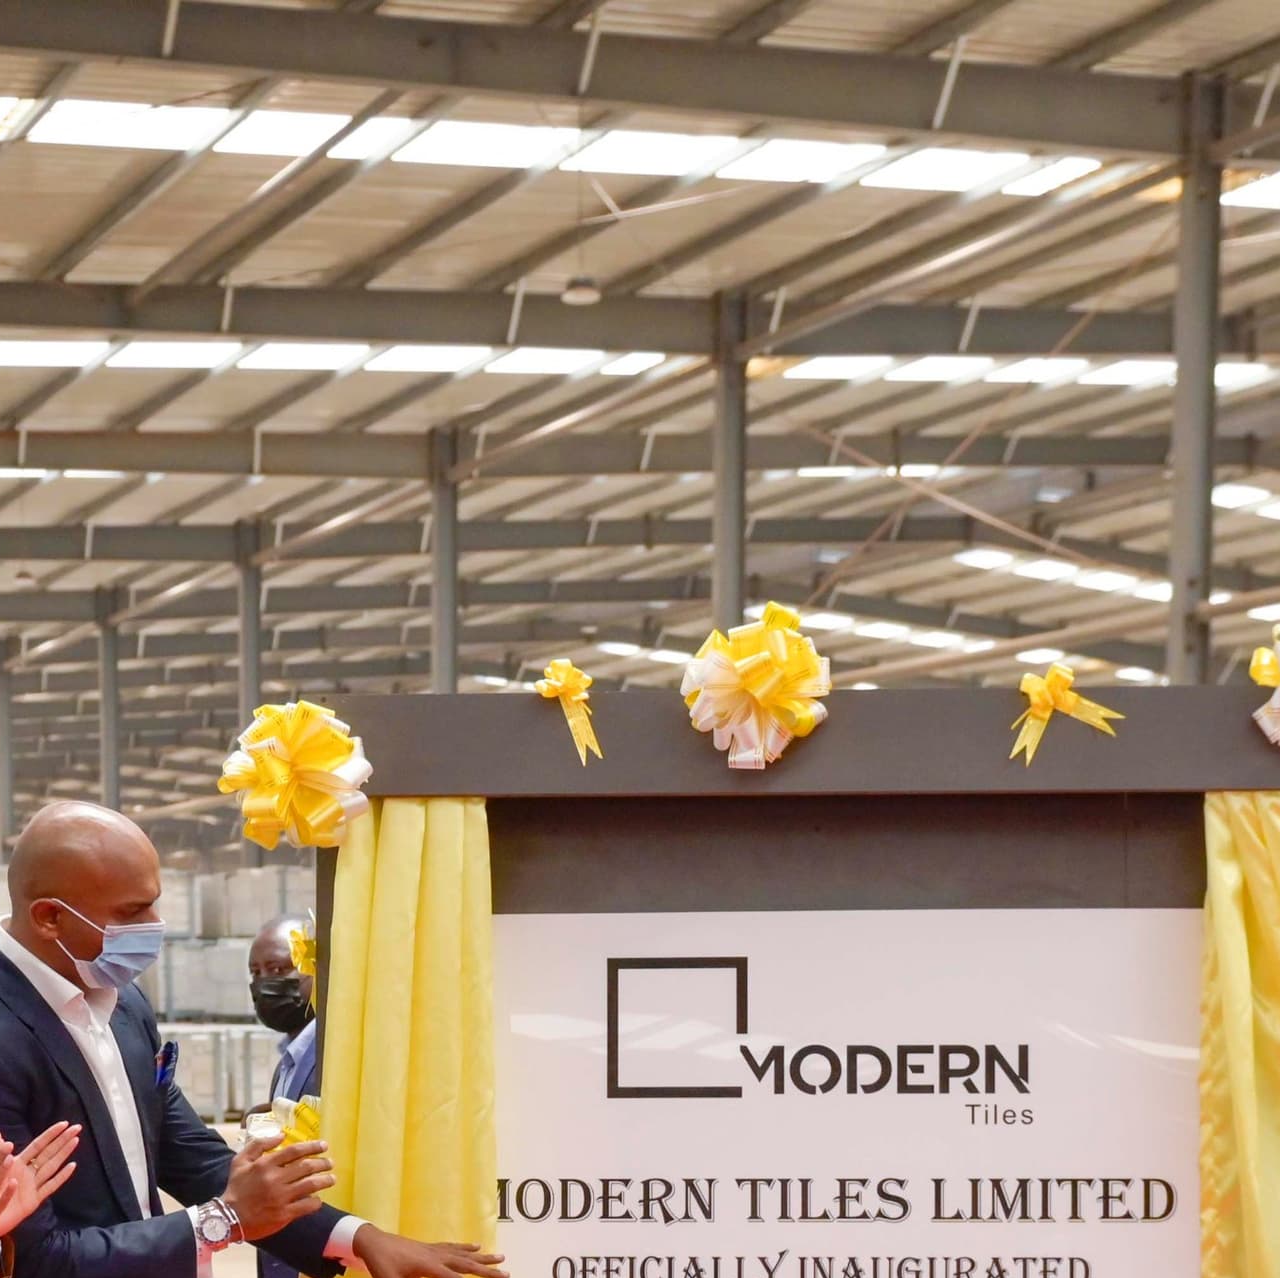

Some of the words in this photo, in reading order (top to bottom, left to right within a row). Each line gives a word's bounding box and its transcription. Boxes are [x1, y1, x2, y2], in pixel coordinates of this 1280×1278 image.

[739, 1043, 1030, 1095] MODERN
[964, 1103, 1035, 1126] Tiles
[735, 1177, 913, 1225] TILES
[930, 1177, 1179, 1225] LIMITED
